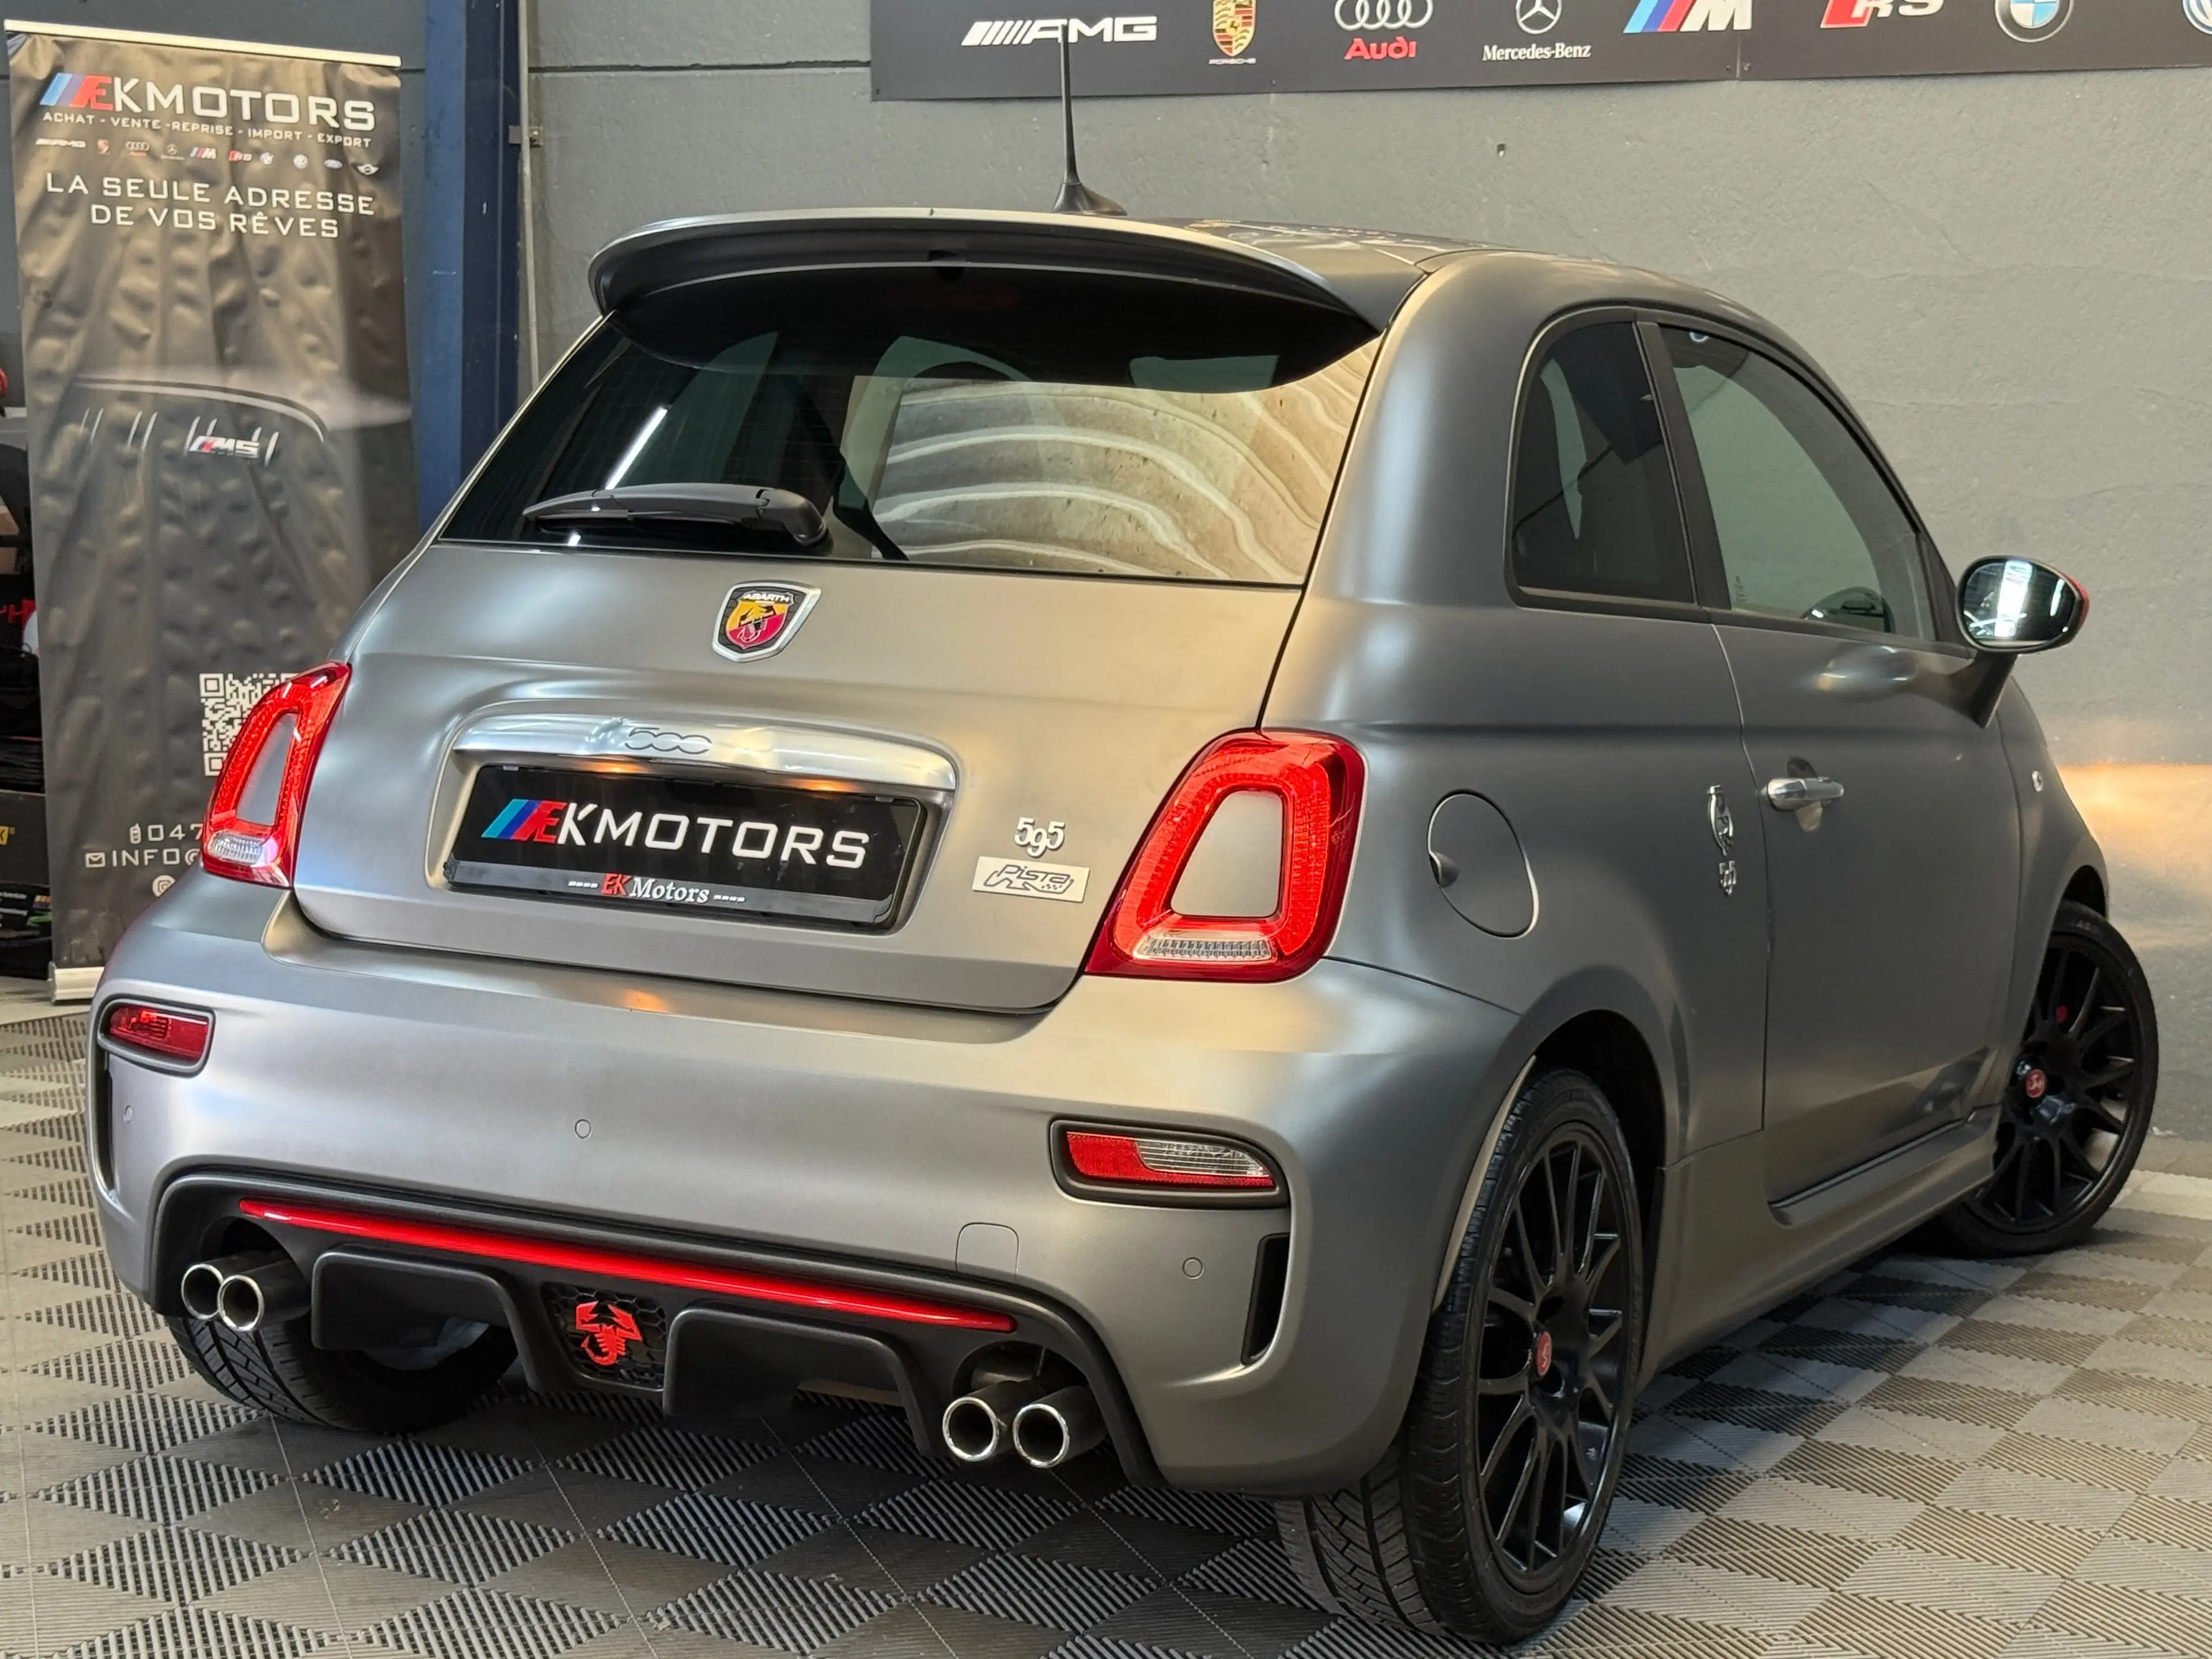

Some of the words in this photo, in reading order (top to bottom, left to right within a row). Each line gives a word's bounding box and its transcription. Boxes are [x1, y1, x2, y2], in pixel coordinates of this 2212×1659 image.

[1344, 36, 1418, 60] Audi
[1482, 43, 1593, 61] Mercedes-Benz
[43, 112, 95, 126] ACHAT
[110, 117, 161, 130] VENTE
[248, 127, 303, 141] IMPORT
[317, 133, 372, 148] EXPORT
[47, 172, 89, 195] LA
[102, 176, 211, 203] SEULE
[224, 185, 375, 216] ADRESSE
[91, 204, 135, 226] DE
[147, 207, 217, 230] VOS
[230, 211, 339, 238] RÊVES
[624, 727, 713, 755] 500
[1014, 817, 1065, 857] 595
[600, 873, 633, 896] EK
[629, 876, 710, 904] Motors
